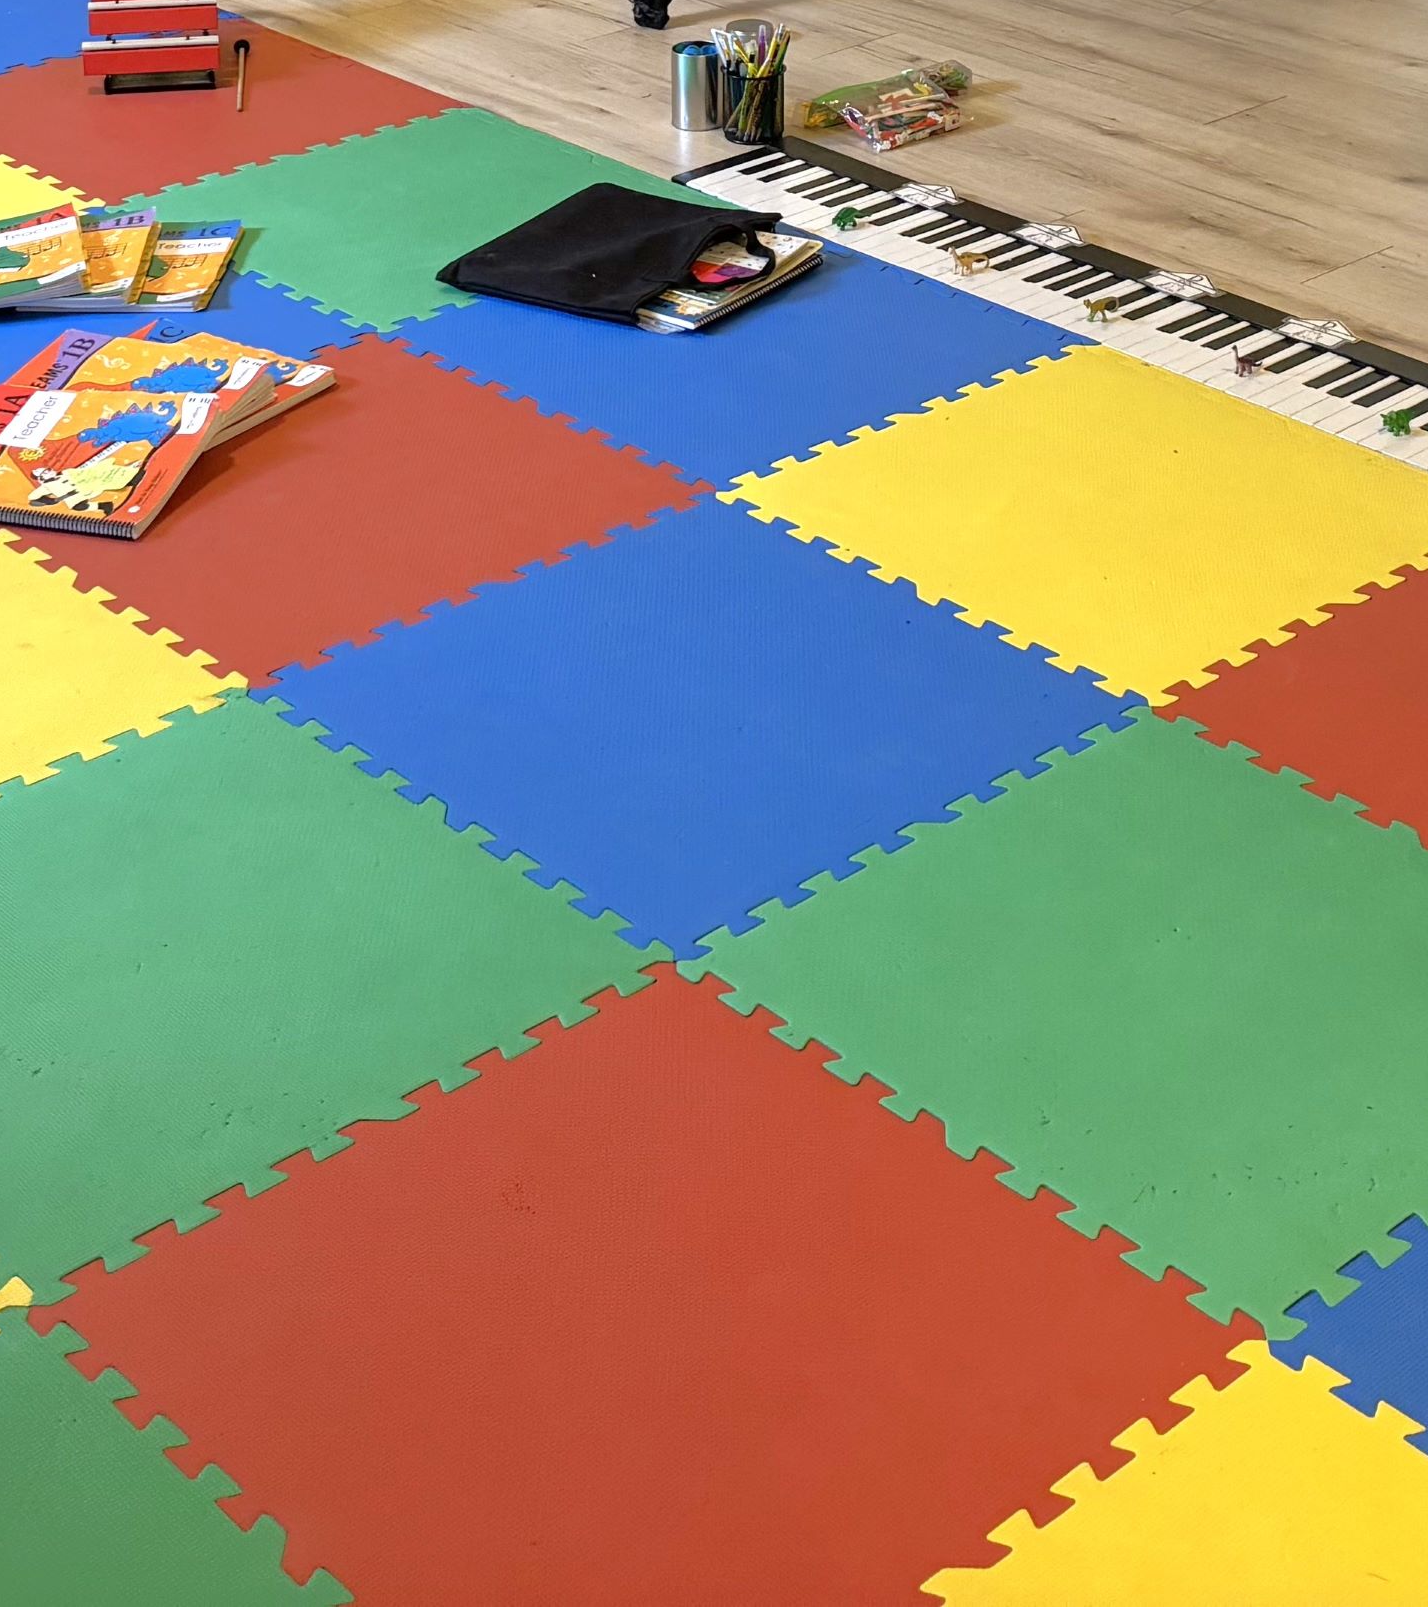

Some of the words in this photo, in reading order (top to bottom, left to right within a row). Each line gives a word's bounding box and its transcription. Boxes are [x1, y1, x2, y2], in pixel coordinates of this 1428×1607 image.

[112, 215, 145, 227] 1B
[198, 226, 232, 237] 1C
[157, 240, 223, 251] Teacher
[62, 336, 97, 360] 1B
[12, 394, 59, 441] Teacher
